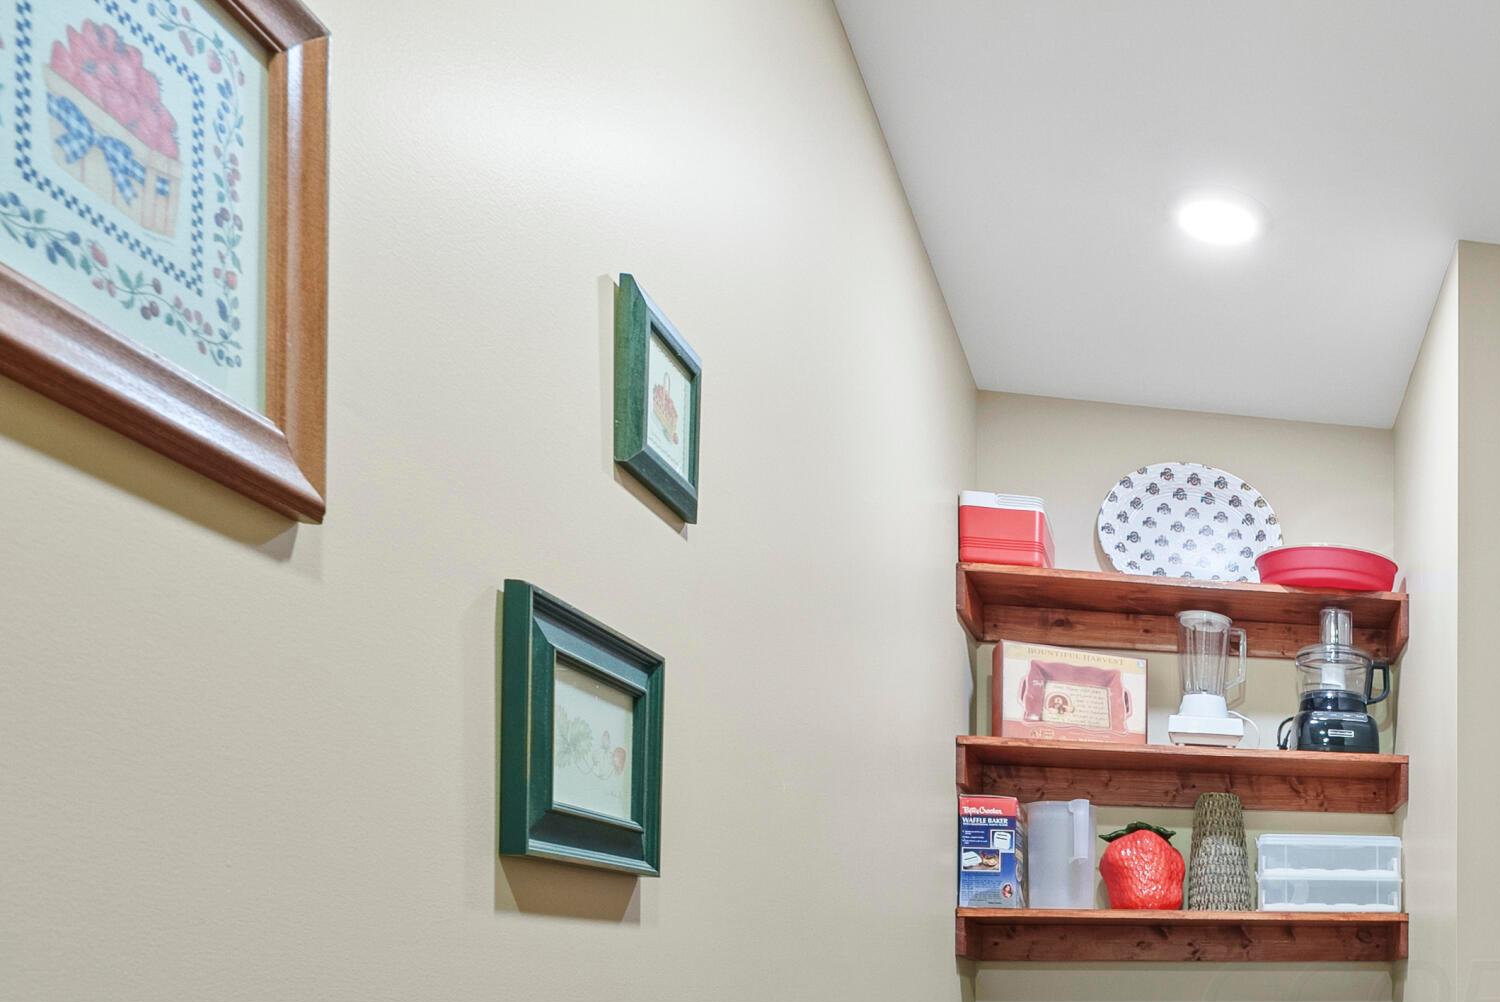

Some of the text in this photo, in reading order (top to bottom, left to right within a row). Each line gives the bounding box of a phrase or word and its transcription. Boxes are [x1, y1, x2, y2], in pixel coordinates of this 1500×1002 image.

[1027, 647, 1124, 666] BOUNTIFUL HARVEST
[962, 816, 1009, 825] WAFFLE BAKER
